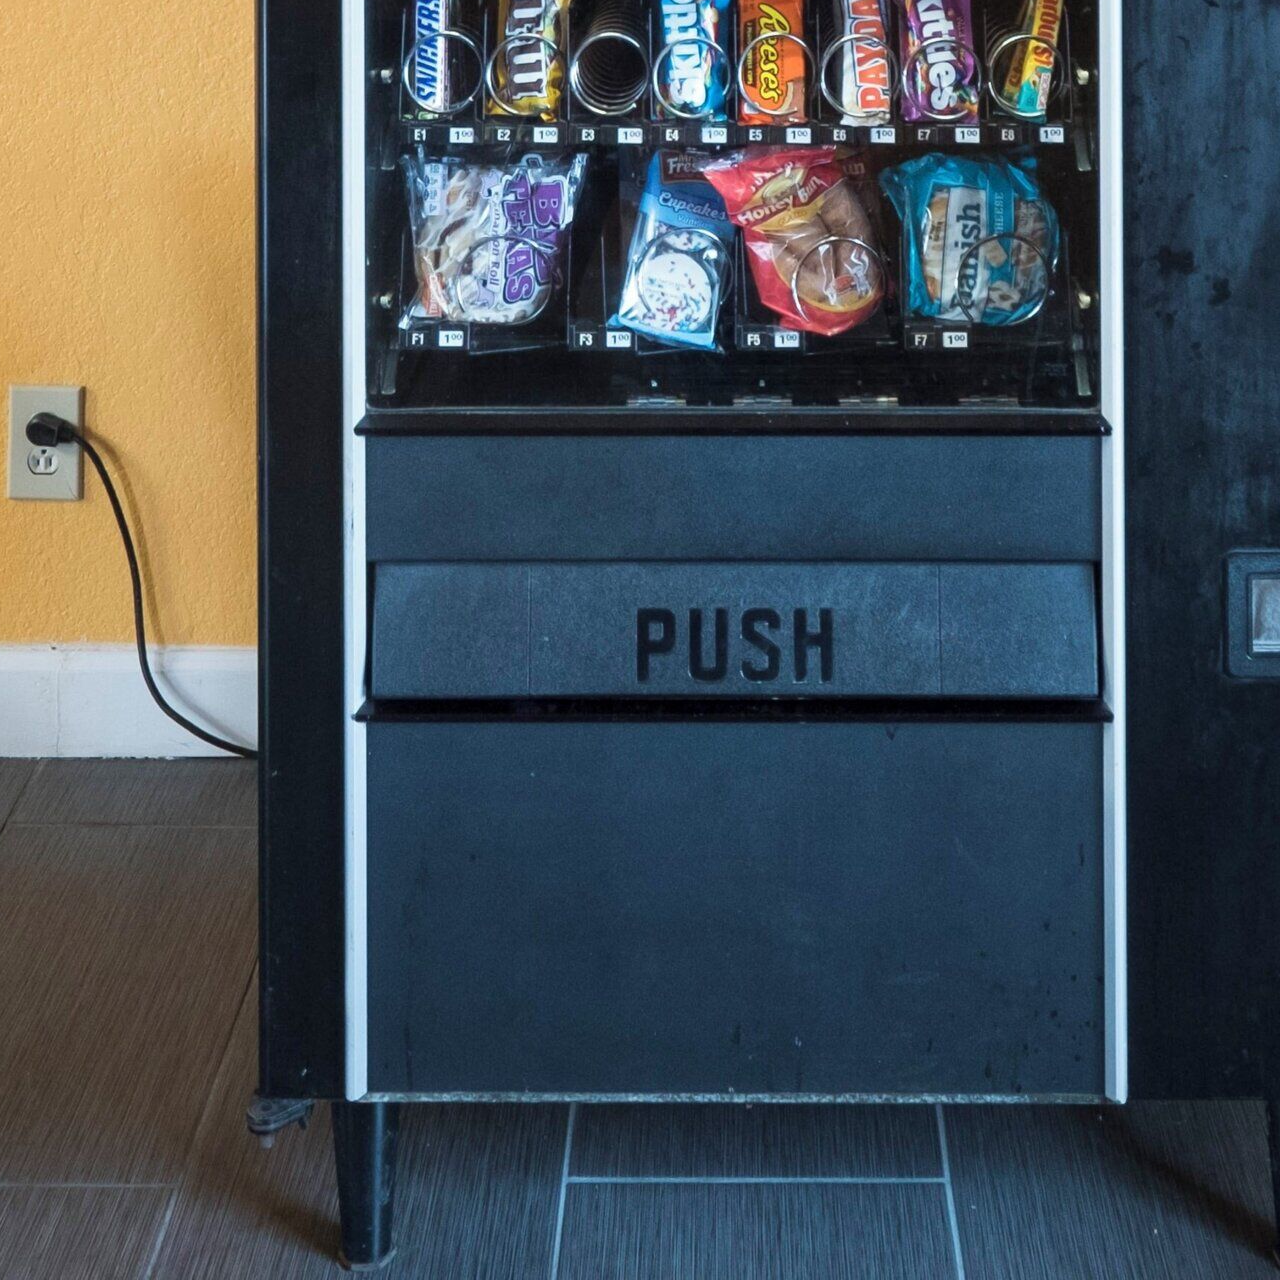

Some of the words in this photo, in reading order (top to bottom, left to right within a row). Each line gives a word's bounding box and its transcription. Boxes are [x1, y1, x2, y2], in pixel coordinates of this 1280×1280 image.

[414, 129, 427, 141] E1
[497, 129, 511, 141] E2
[581, 129, 595, 141] E3
[665, 129, 679, 141] E4
[748, 129, 763, 141] E5
[833, 129, 847, 141] E6
[917, 129, 931, 141] E7
[1001, 129, 1015, 141] E8
[658, 191, 727, 221] Cupcakes
[737, 195, 795, 225] Honey
[797, 175, 823, 203] Bun
[502, 169, 536, 304] TEXAS
[489, 261, 501, 286] Roll
[411, 333, 424, 345] F1
[579, 334, 593, 345] F3
[747, 334, 760, 346] F5
[914, 334, 927, 346] F7
[636, 607, 833, 684] PUSH
